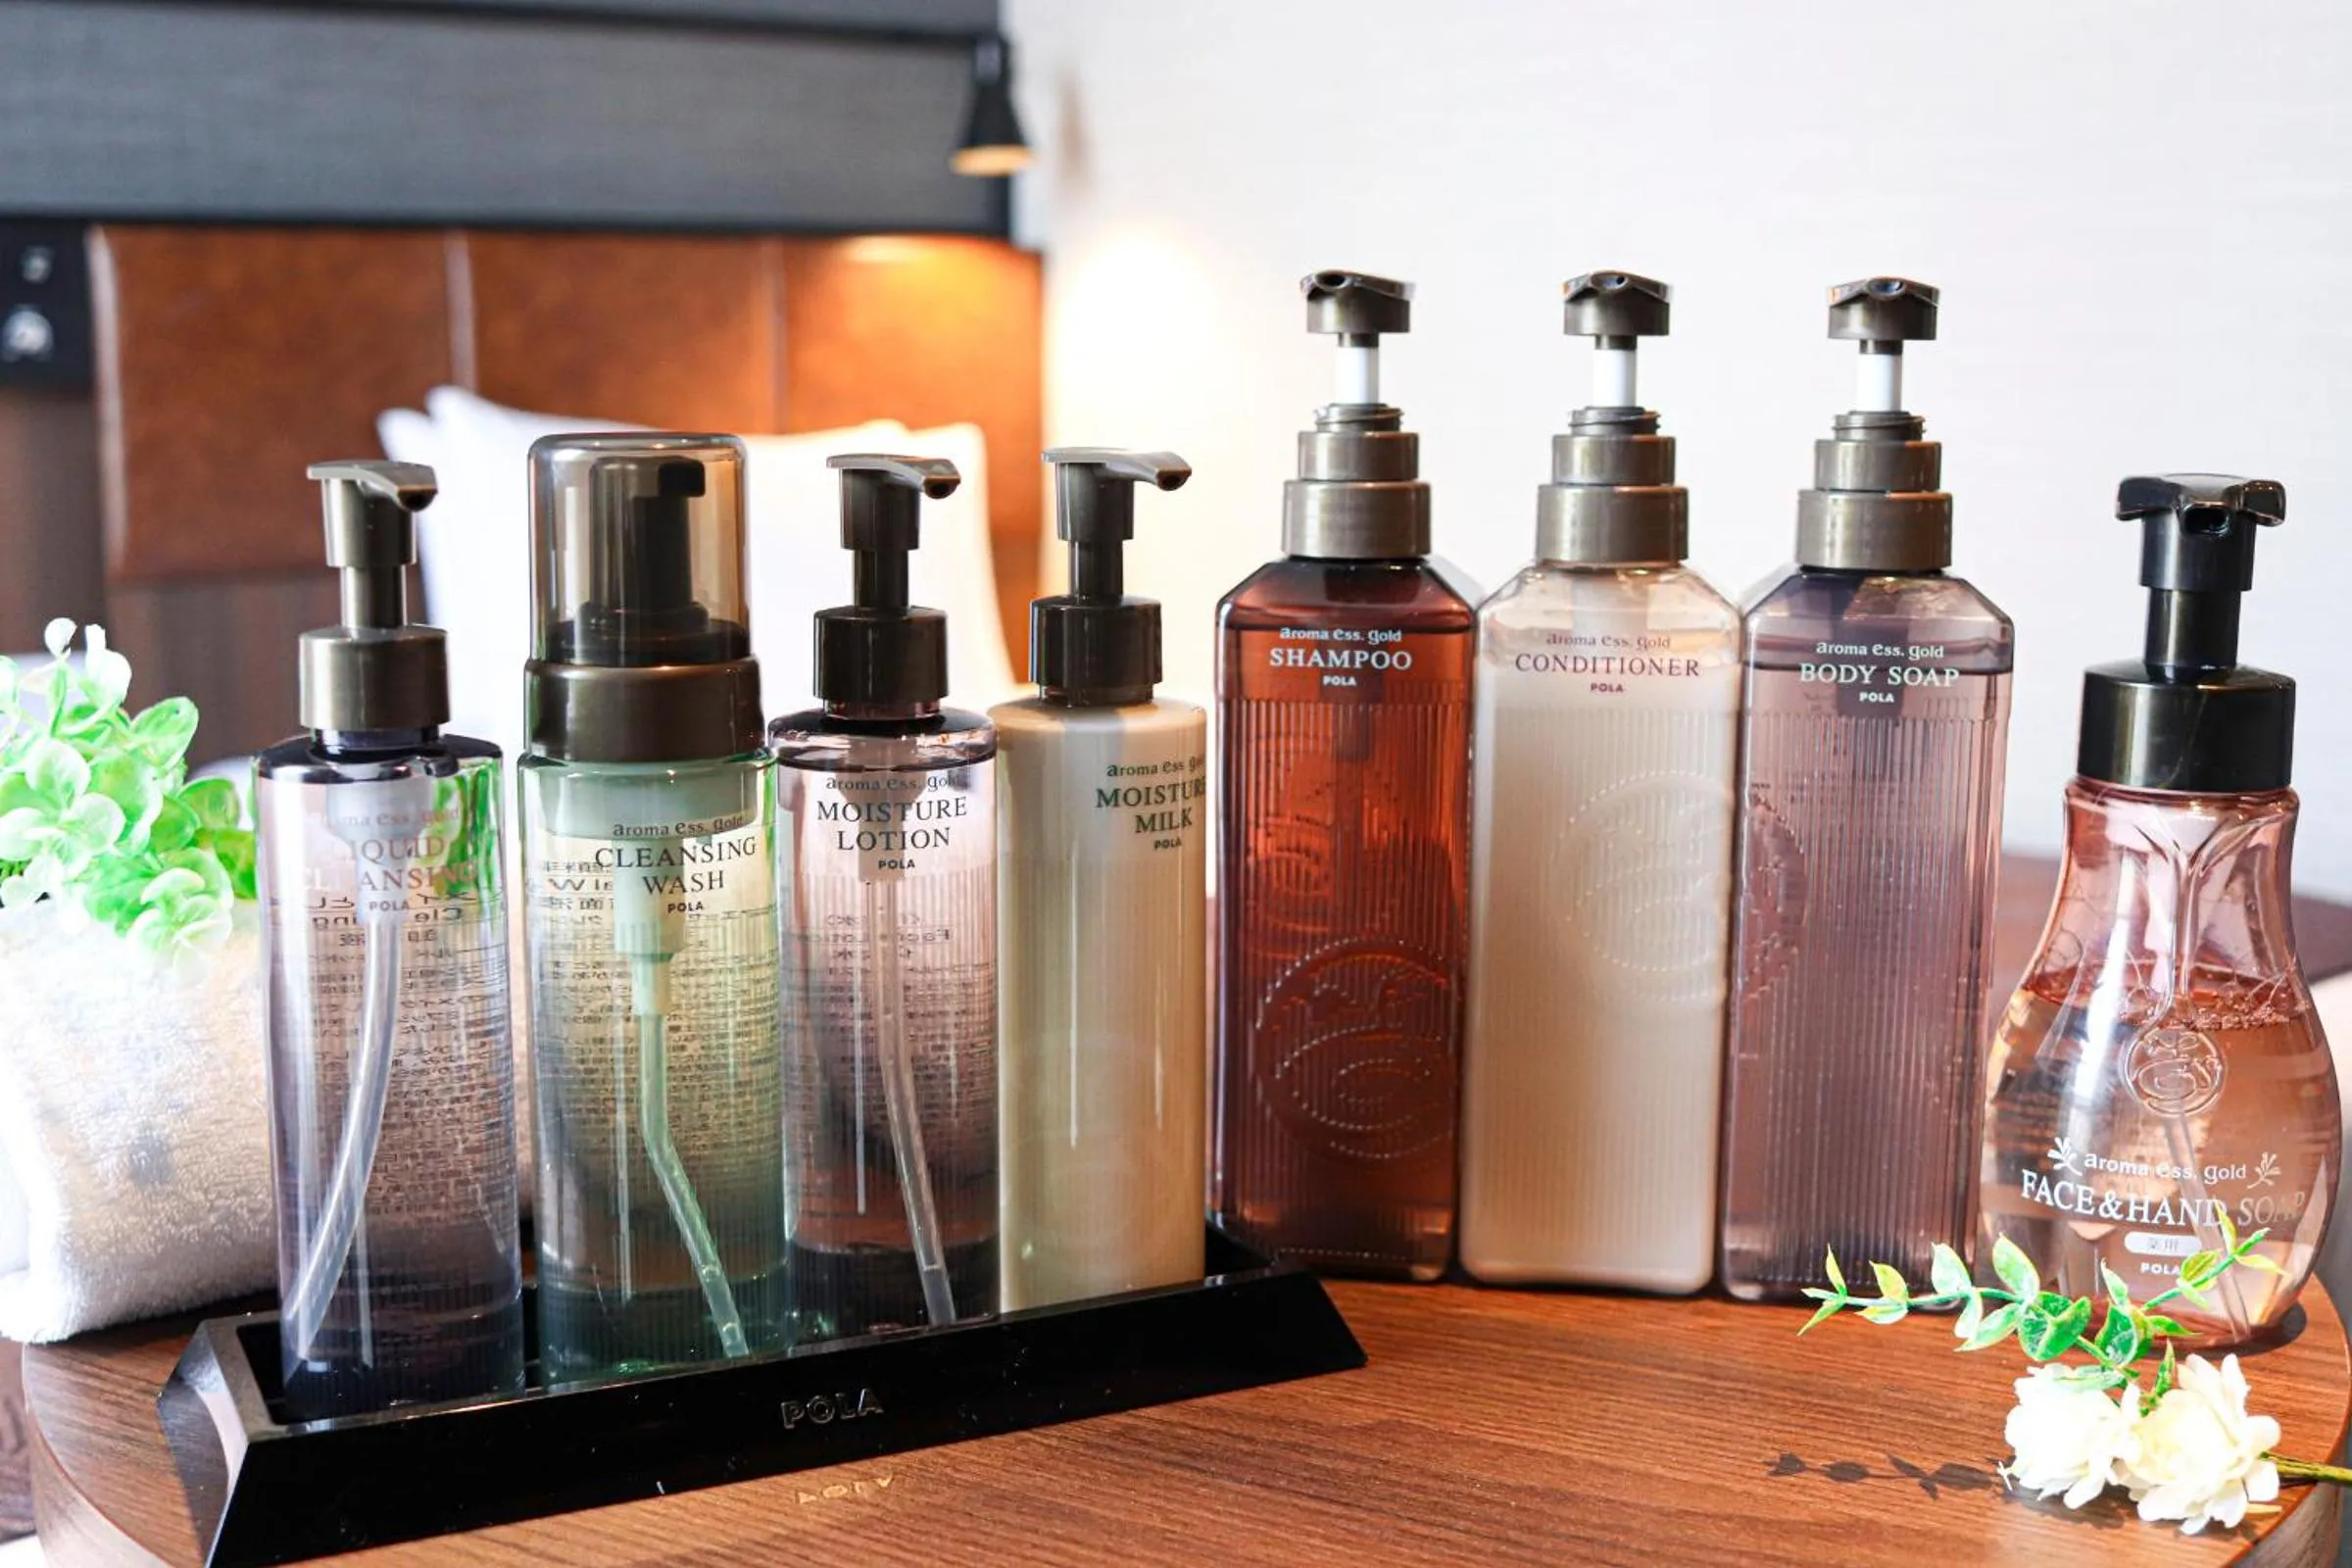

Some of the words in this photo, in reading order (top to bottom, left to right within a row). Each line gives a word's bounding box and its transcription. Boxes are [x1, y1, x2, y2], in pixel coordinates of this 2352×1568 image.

[1279, 627, 1329, 640] aroma
[1333, 628, 1364, 641] ess.
[1368, 629, 1402, 645] gold
[1545, 633, 1596, 646] aroma
[1637, 635, 1671, 651] gold
[1269, 647, 1412, 670] SHAMPOO
[1816, 642, 1867, 656] aroma
[1872, 643, 1905, 658] ess.
[1909, 645, 1944, 661] gold
[1515, 653, 1700, 676] CONDITIONER
[1322, 675, 1357, 686] POLA
[1799, 662, 1877, 684] BODY
[1886, 665, 1960, 687] SOAP
[1591, 683, 1625, 693] POLA
[1859, 691, 1895, 703] POLA
[1106, 764, 1158, 777] aroma
[826, 775, 880, 790] aroma
[1095, 775, 1206, 808] MOISTUR
[816, 796, 968, 822] MOISTURE
[612, 822, 669, 836] aroma
[1135, 807, 1193, 834] MILK
[837, 827, 952, 851] LOTION
[1153, 836, 1182, 851] POLA
[595, 835, 757, 868] CLEANSING
[878, 858, 916, 870] POLA
[643, 869, 725, 896] WASH
[368, 901, 411, 911] POLA
[666, 901, 705, 913] POLA
[2083, 1153, 2150, 1177] aroma
[2203, 1164, 2246, 1185] gold
[781, 1388, 884, 1430] POLA
